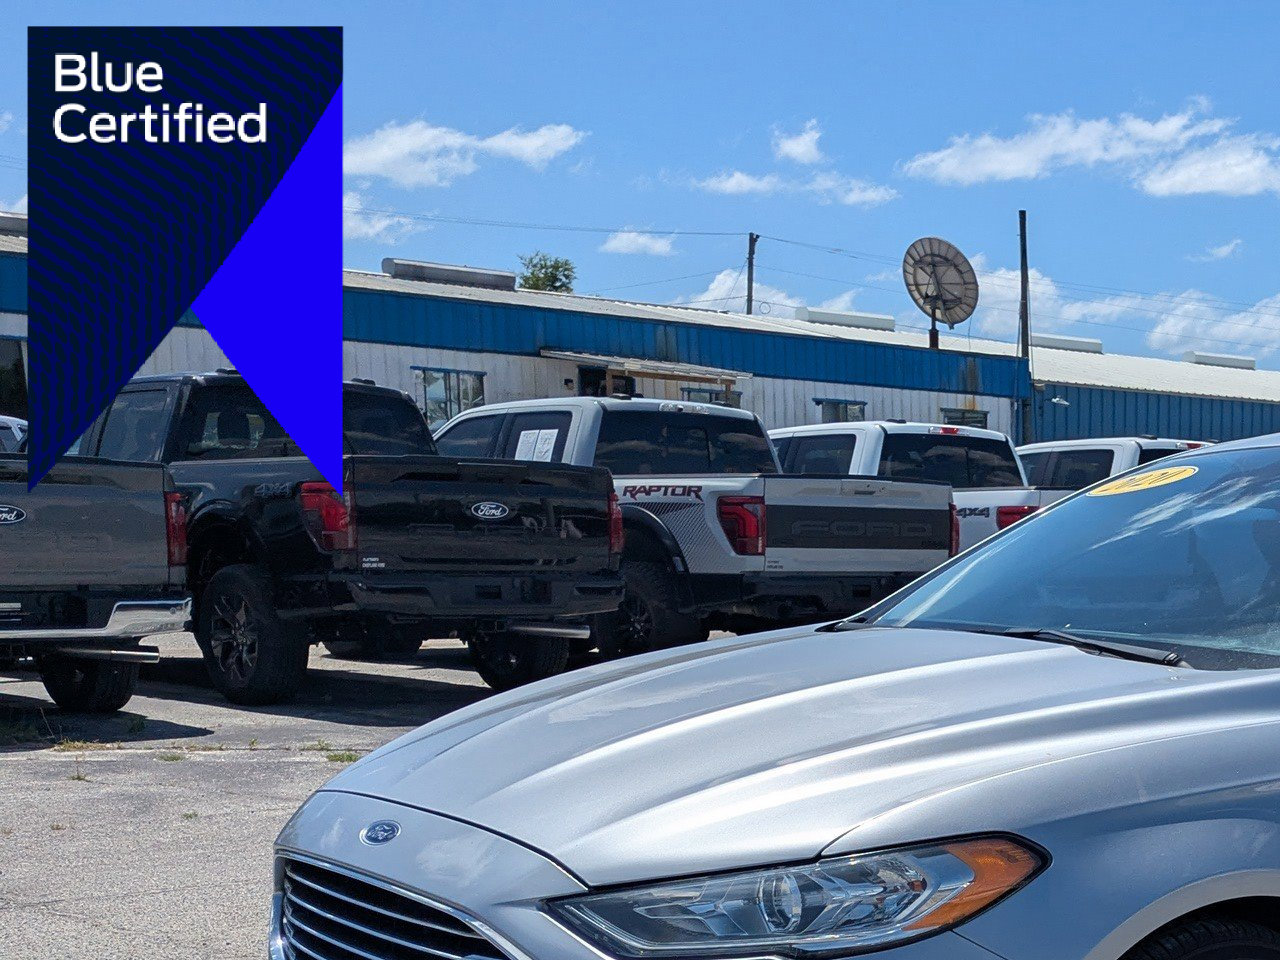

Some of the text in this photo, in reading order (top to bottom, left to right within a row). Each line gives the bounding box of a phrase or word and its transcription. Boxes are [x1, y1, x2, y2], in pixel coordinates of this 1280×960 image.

[622, 485, 704, 502] RAPTOR
[477, 504, 503, 516] Ford
[791, 520, 933, 537] FORD
